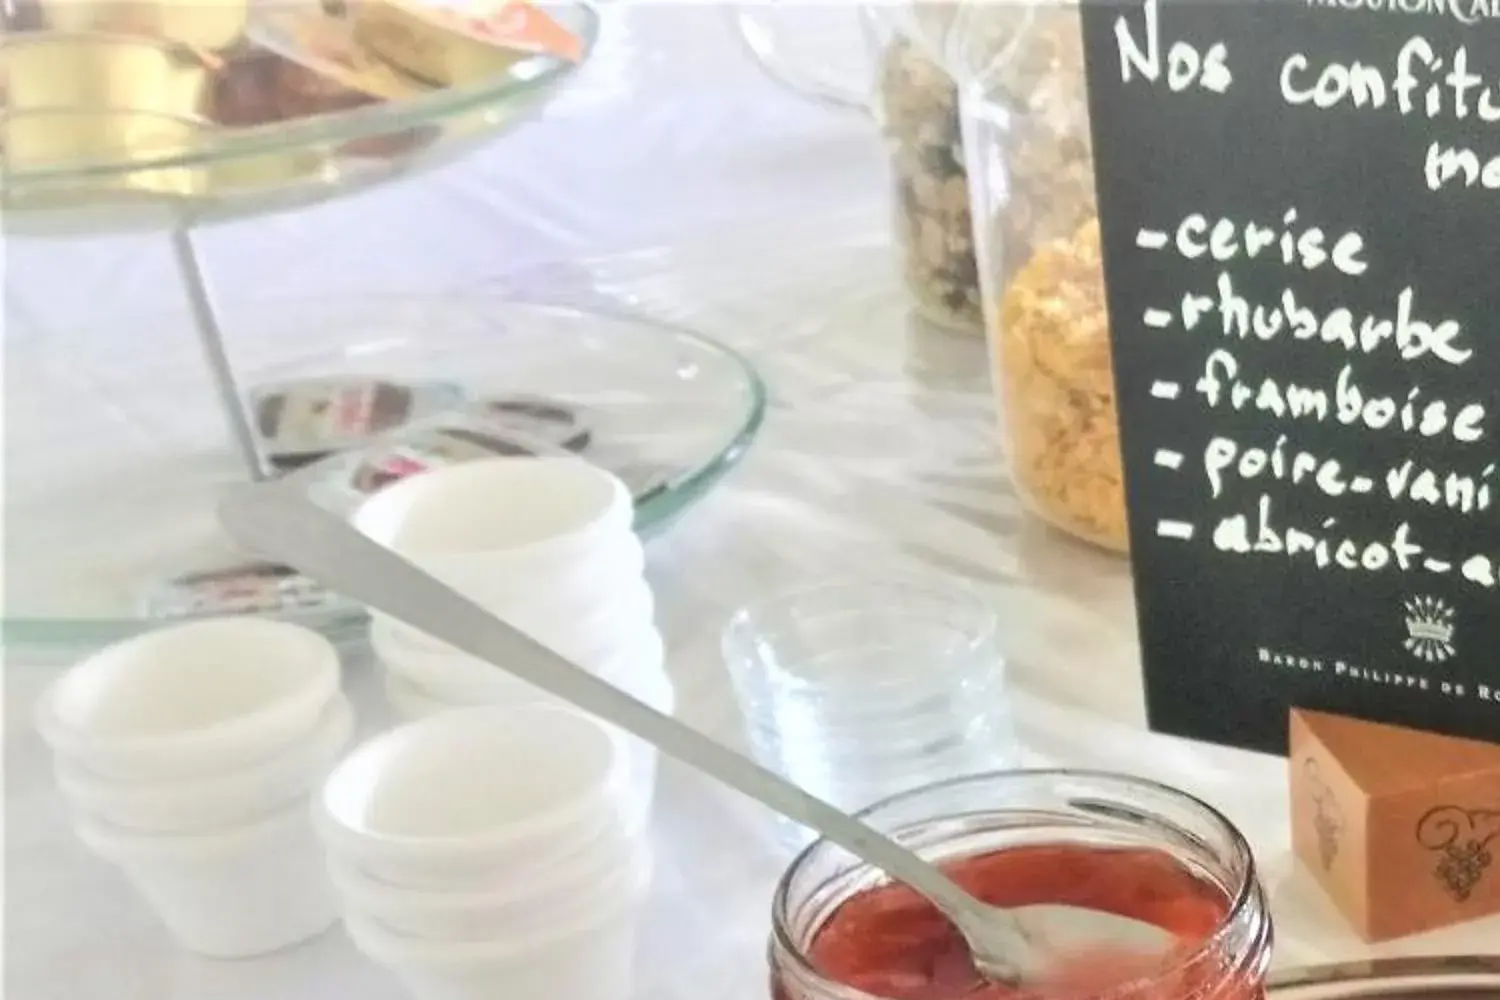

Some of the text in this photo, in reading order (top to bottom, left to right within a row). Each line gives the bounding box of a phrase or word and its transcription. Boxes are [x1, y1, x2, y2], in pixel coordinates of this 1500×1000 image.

[1113, 0, 1233, 94] Nos
[1258, 648, 1322, 672] BARON
[1335, 661, 1428, 689] PHILIPPE
